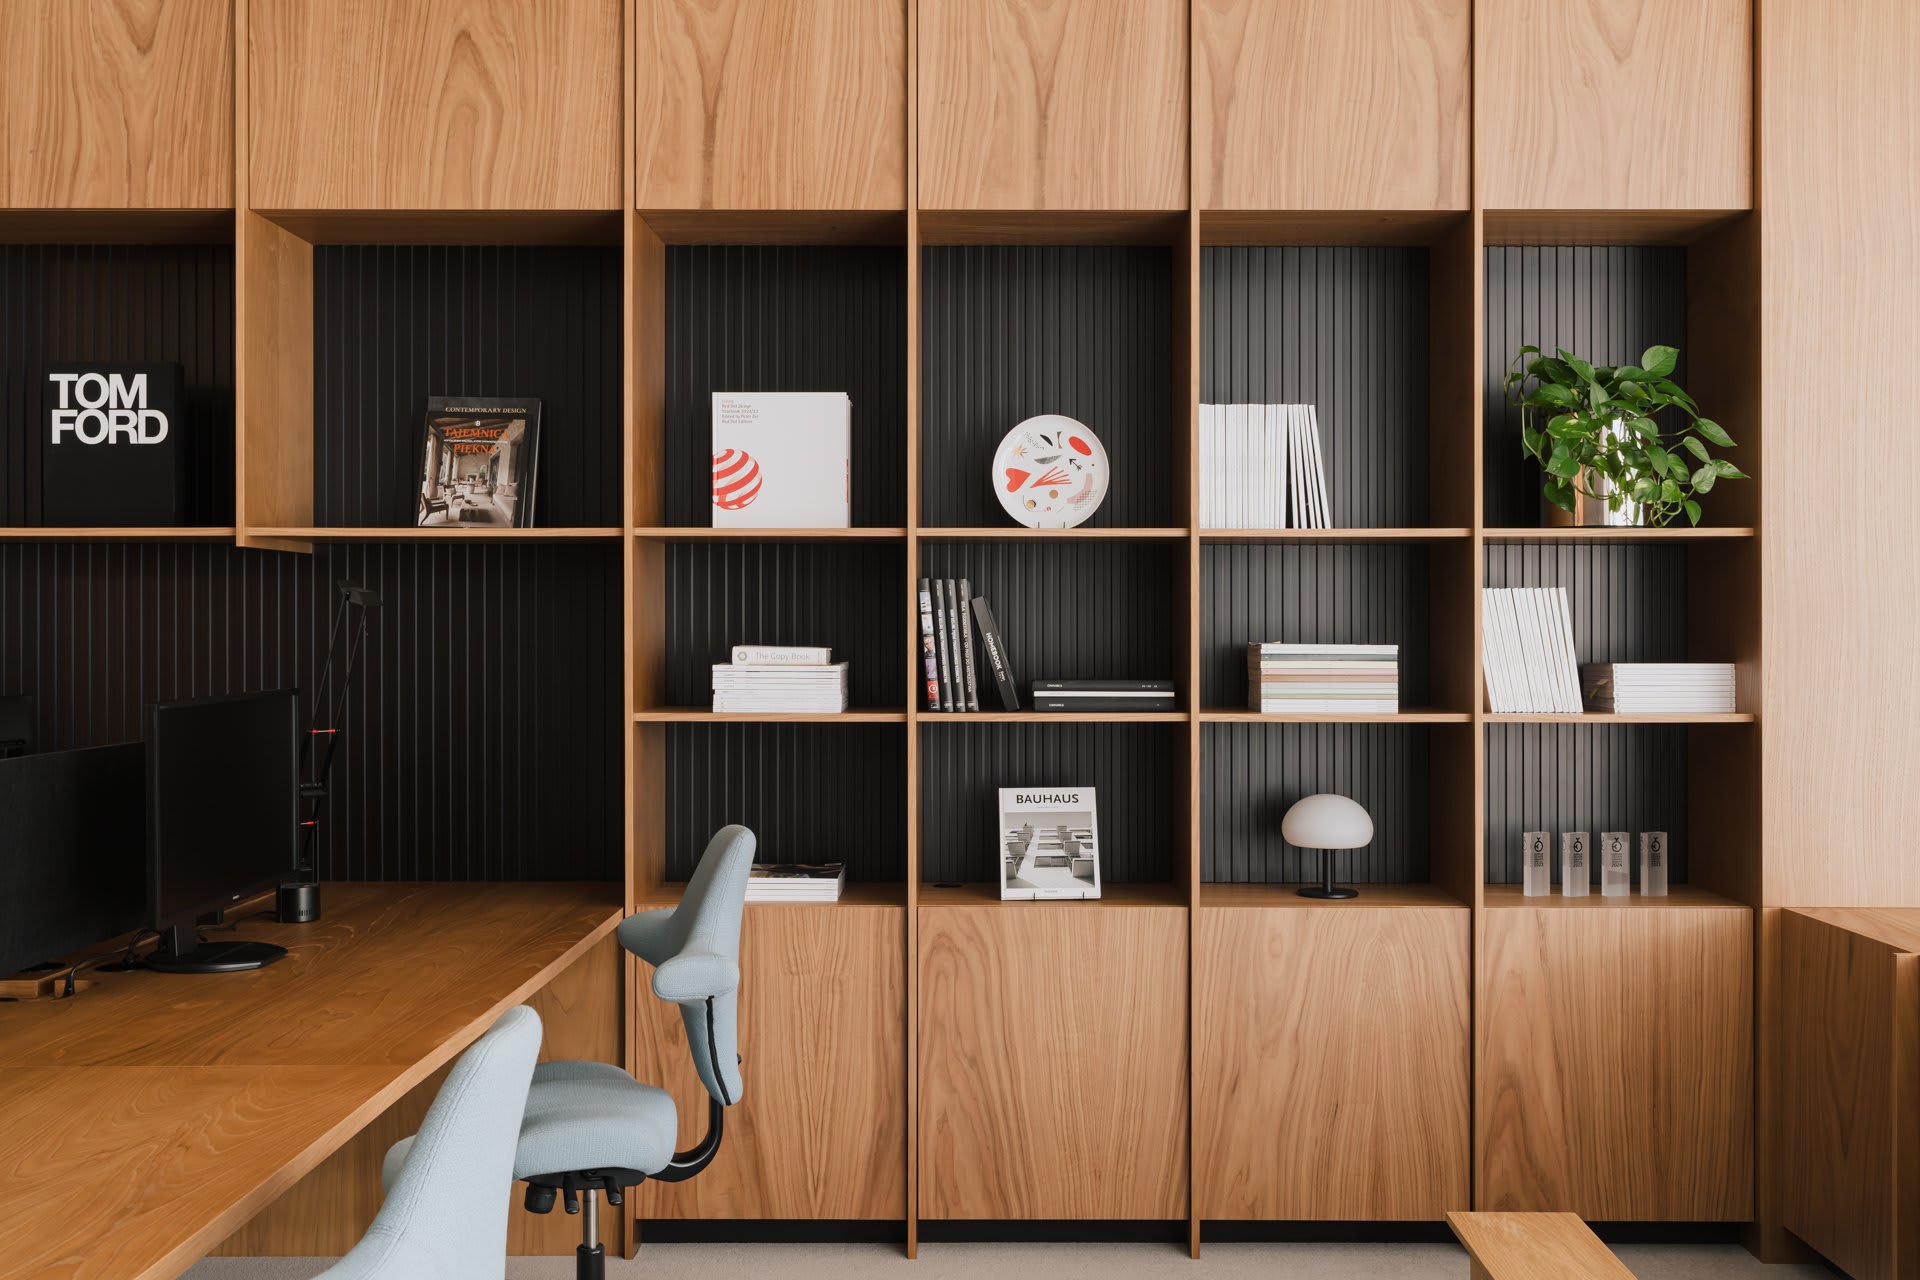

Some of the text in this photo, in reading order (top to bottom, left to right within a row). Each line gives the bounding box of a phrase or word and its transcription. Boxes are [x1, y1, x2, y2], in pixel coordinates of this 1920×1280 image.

[49, 373, 147, 409] TOM
[445, 406, 502, 414] CONTEMPORARY
[51, 408, 169, 445] FORD
[756, 651, 809, 661] The Copy Book
[985, 632, 1003, 670] HOMEBOOK
[1016, 794, 1080, 804] BAUHAUS
